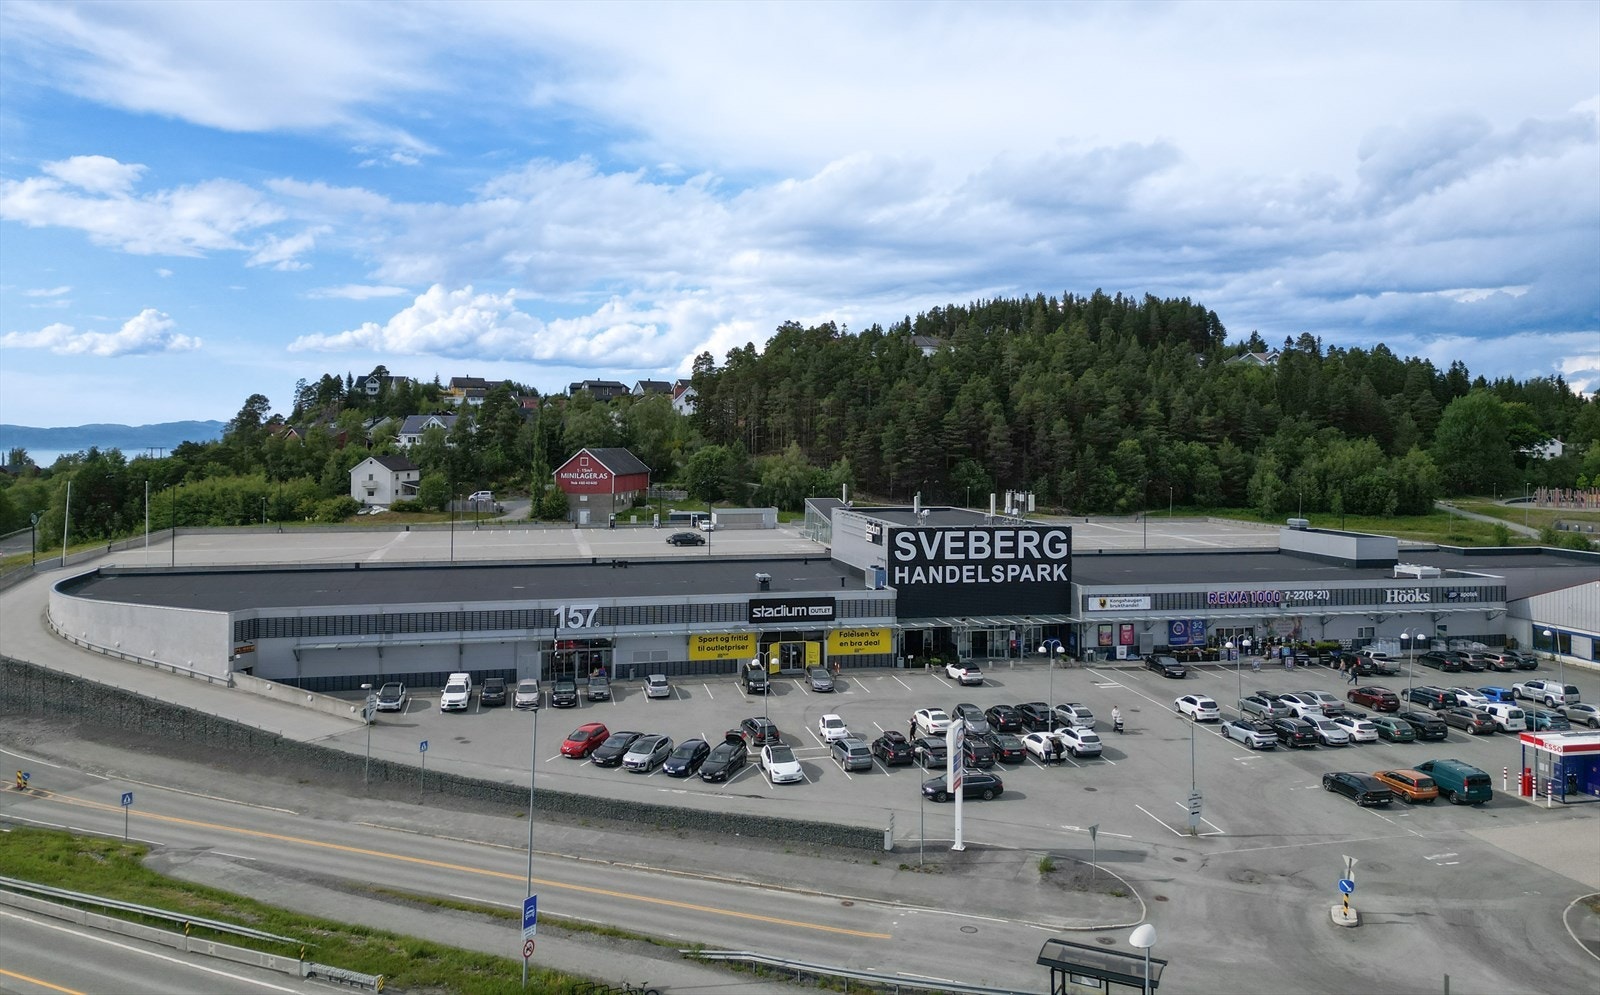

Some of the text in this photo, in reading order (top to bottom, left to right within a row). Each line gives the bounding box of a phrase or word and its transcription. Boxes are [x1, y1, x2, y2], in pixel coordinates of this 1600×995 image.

[894, 530, 1068, 561] SVEBERG
[895, 564, 1068, 584] HANDELSPARK
[1208, 591, 1248, 604] REMA
[1250, 590, 1281, 603] 1000
[1385, 588, 1430, 603] Hööks
[752, 605, 807, 617] stadium
[1544, 743, 1562, 752] ESSO
